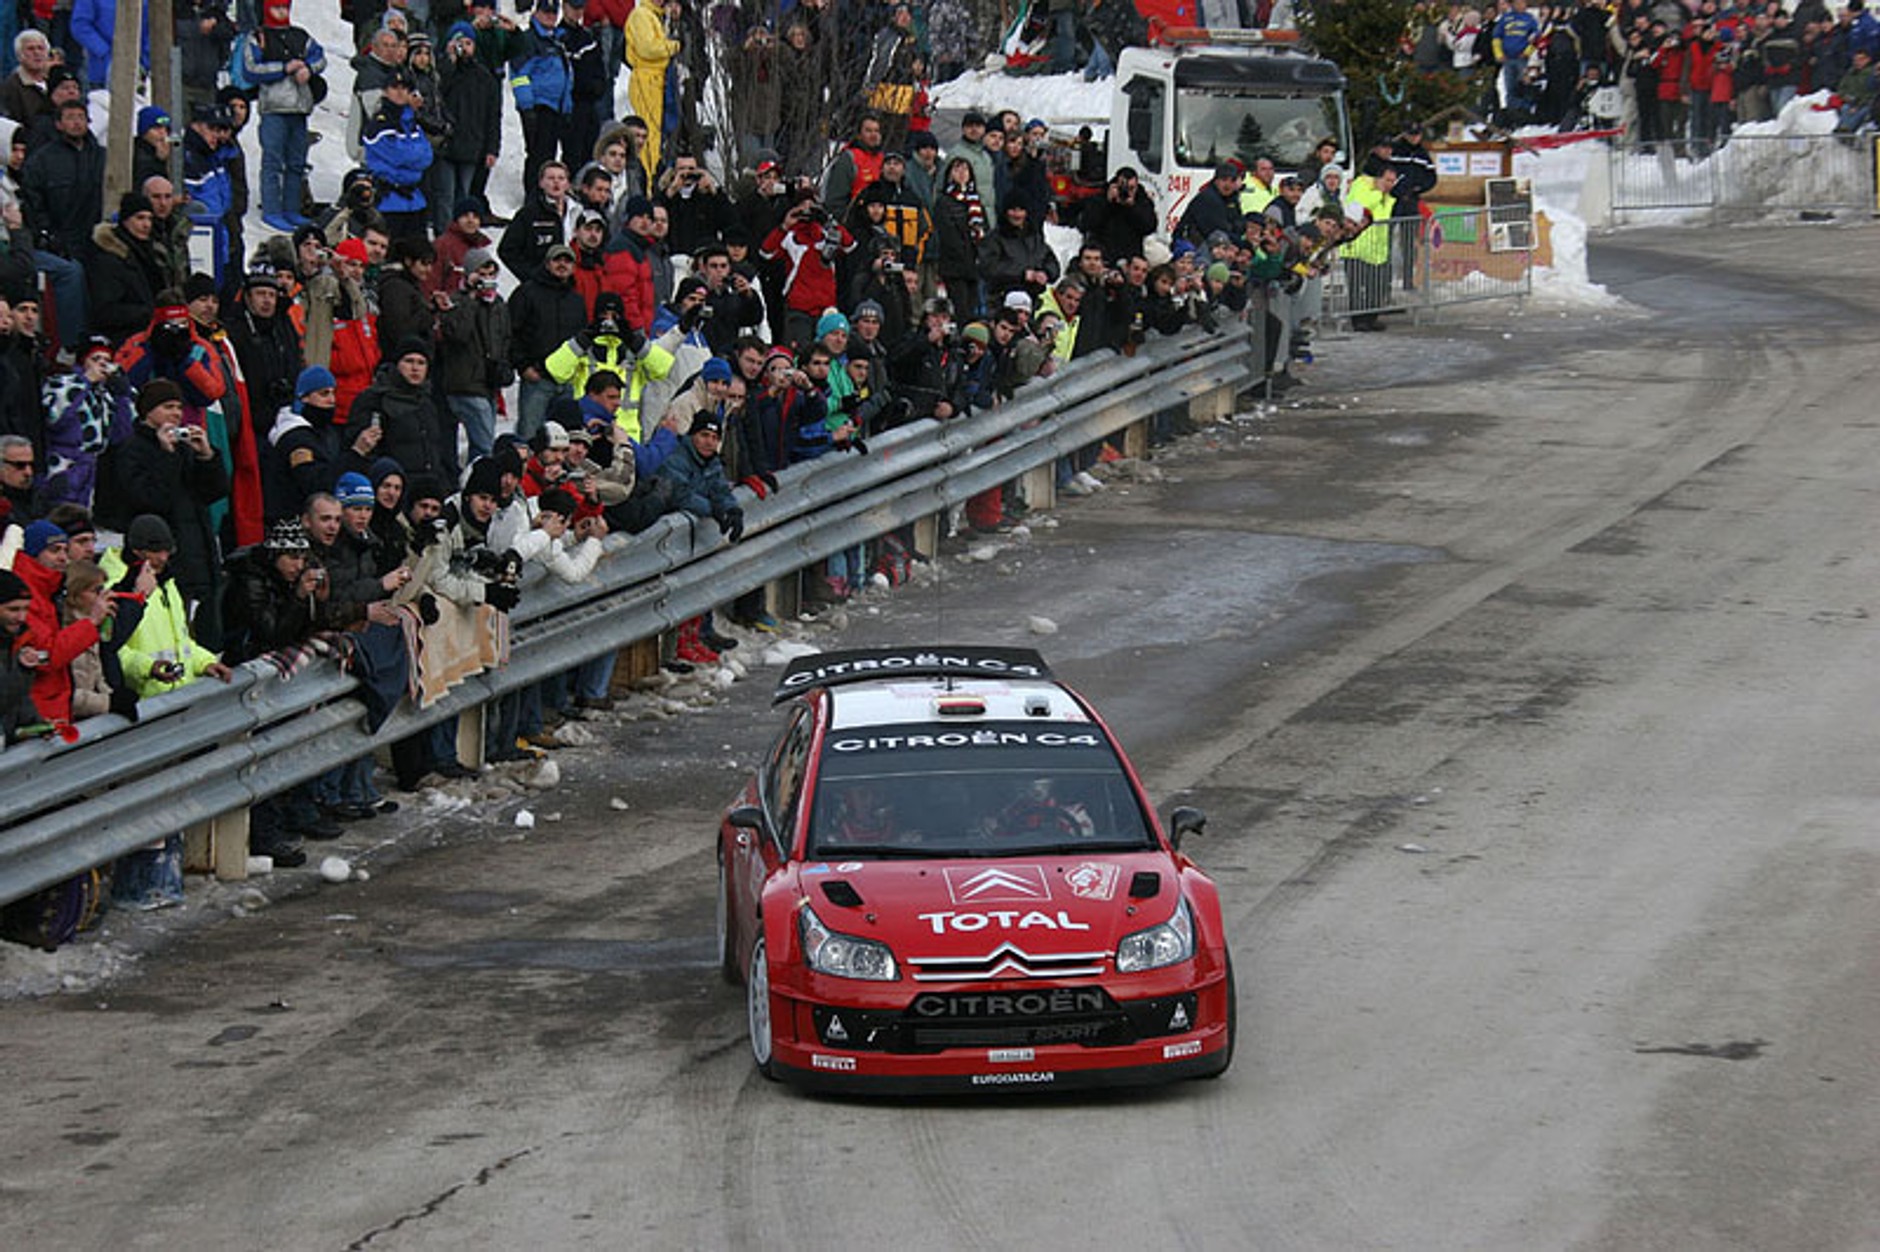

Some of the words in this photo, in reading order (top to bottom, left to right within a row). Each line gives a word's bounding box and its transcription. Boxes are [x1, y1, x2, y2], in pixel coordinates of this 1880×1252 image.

[1168, 175, 1191, 191] 24H
[784, 653, 969, 686] CITROËN
[977, 659, 1041, 677] C4
[832, 730, 1028, 751] CITROËN
[1036, 732, 1099, 746] C4
[917, 911, 1090, 934] TOTAL
[915, 989, 1104, 1016] CITROËN
